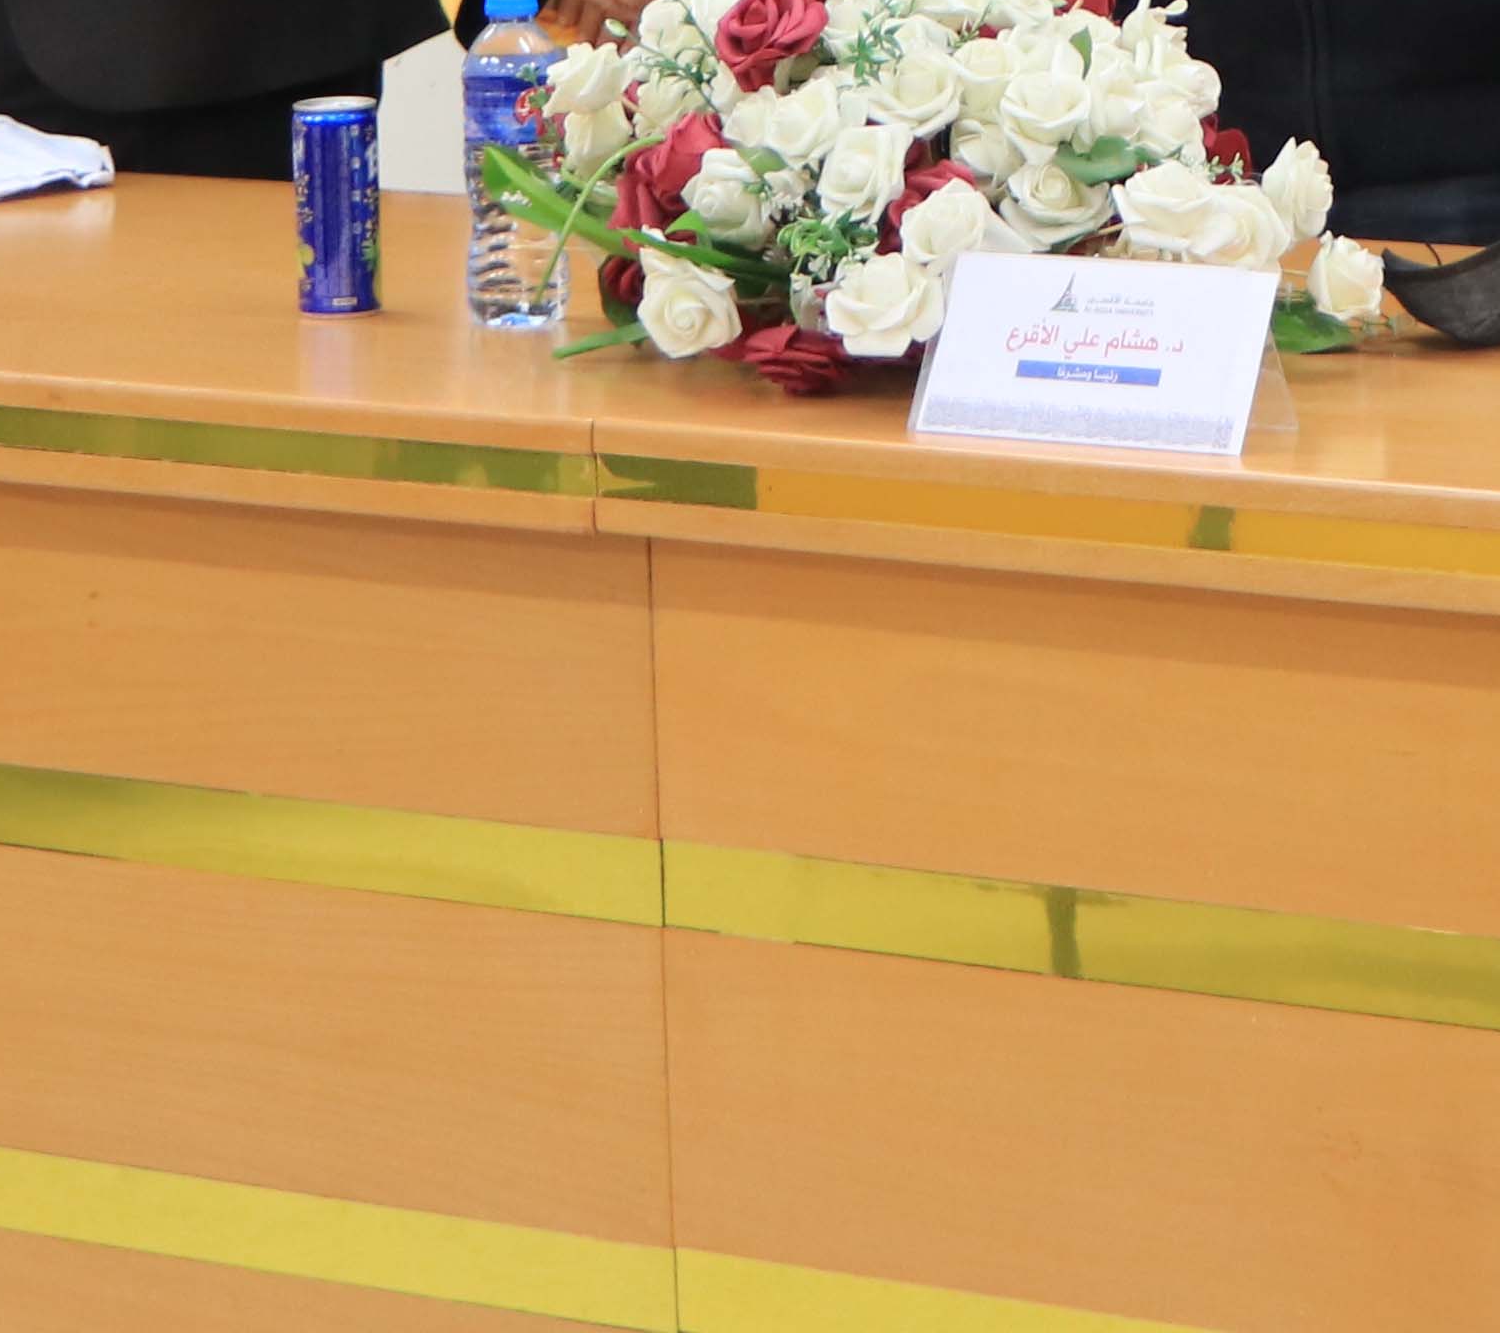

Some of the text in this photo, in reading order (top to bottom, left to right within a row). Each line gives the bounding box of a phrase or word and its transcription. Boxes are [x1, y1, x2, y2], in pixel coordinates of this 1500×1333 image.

[1004, 317, 1061, 354] الأقرع
[1063, 325, 1100, 360] علي
[1104, 329, 1160, 358] هشام
